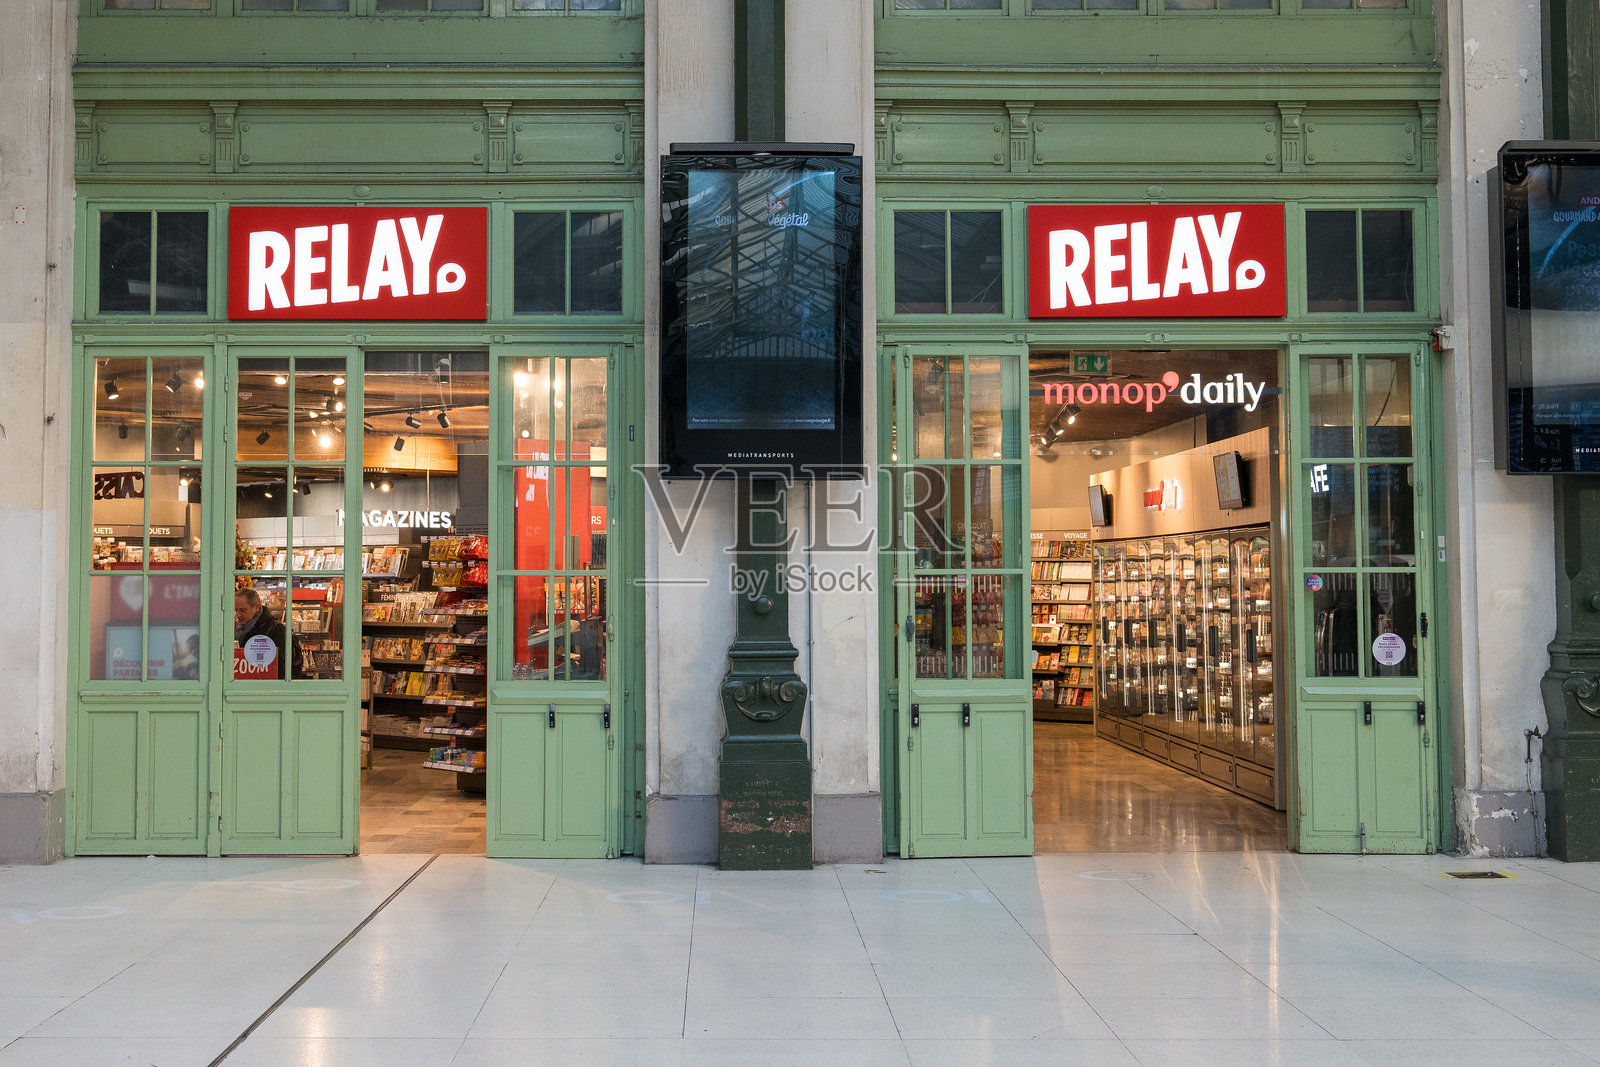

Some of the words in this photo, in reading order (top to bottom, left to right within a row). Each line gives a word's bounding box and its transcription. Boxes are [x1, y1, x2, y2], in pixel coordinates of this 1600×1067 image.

[1553, 211, 1596, 222] GOURMAND
[957, 522, 987, 530] CHCOLAT
[94, 527, 114, 535] UETS
[380, 593, 398, 602] FÉMIN
[113, 659, 165, 667] DÉCOURIR
